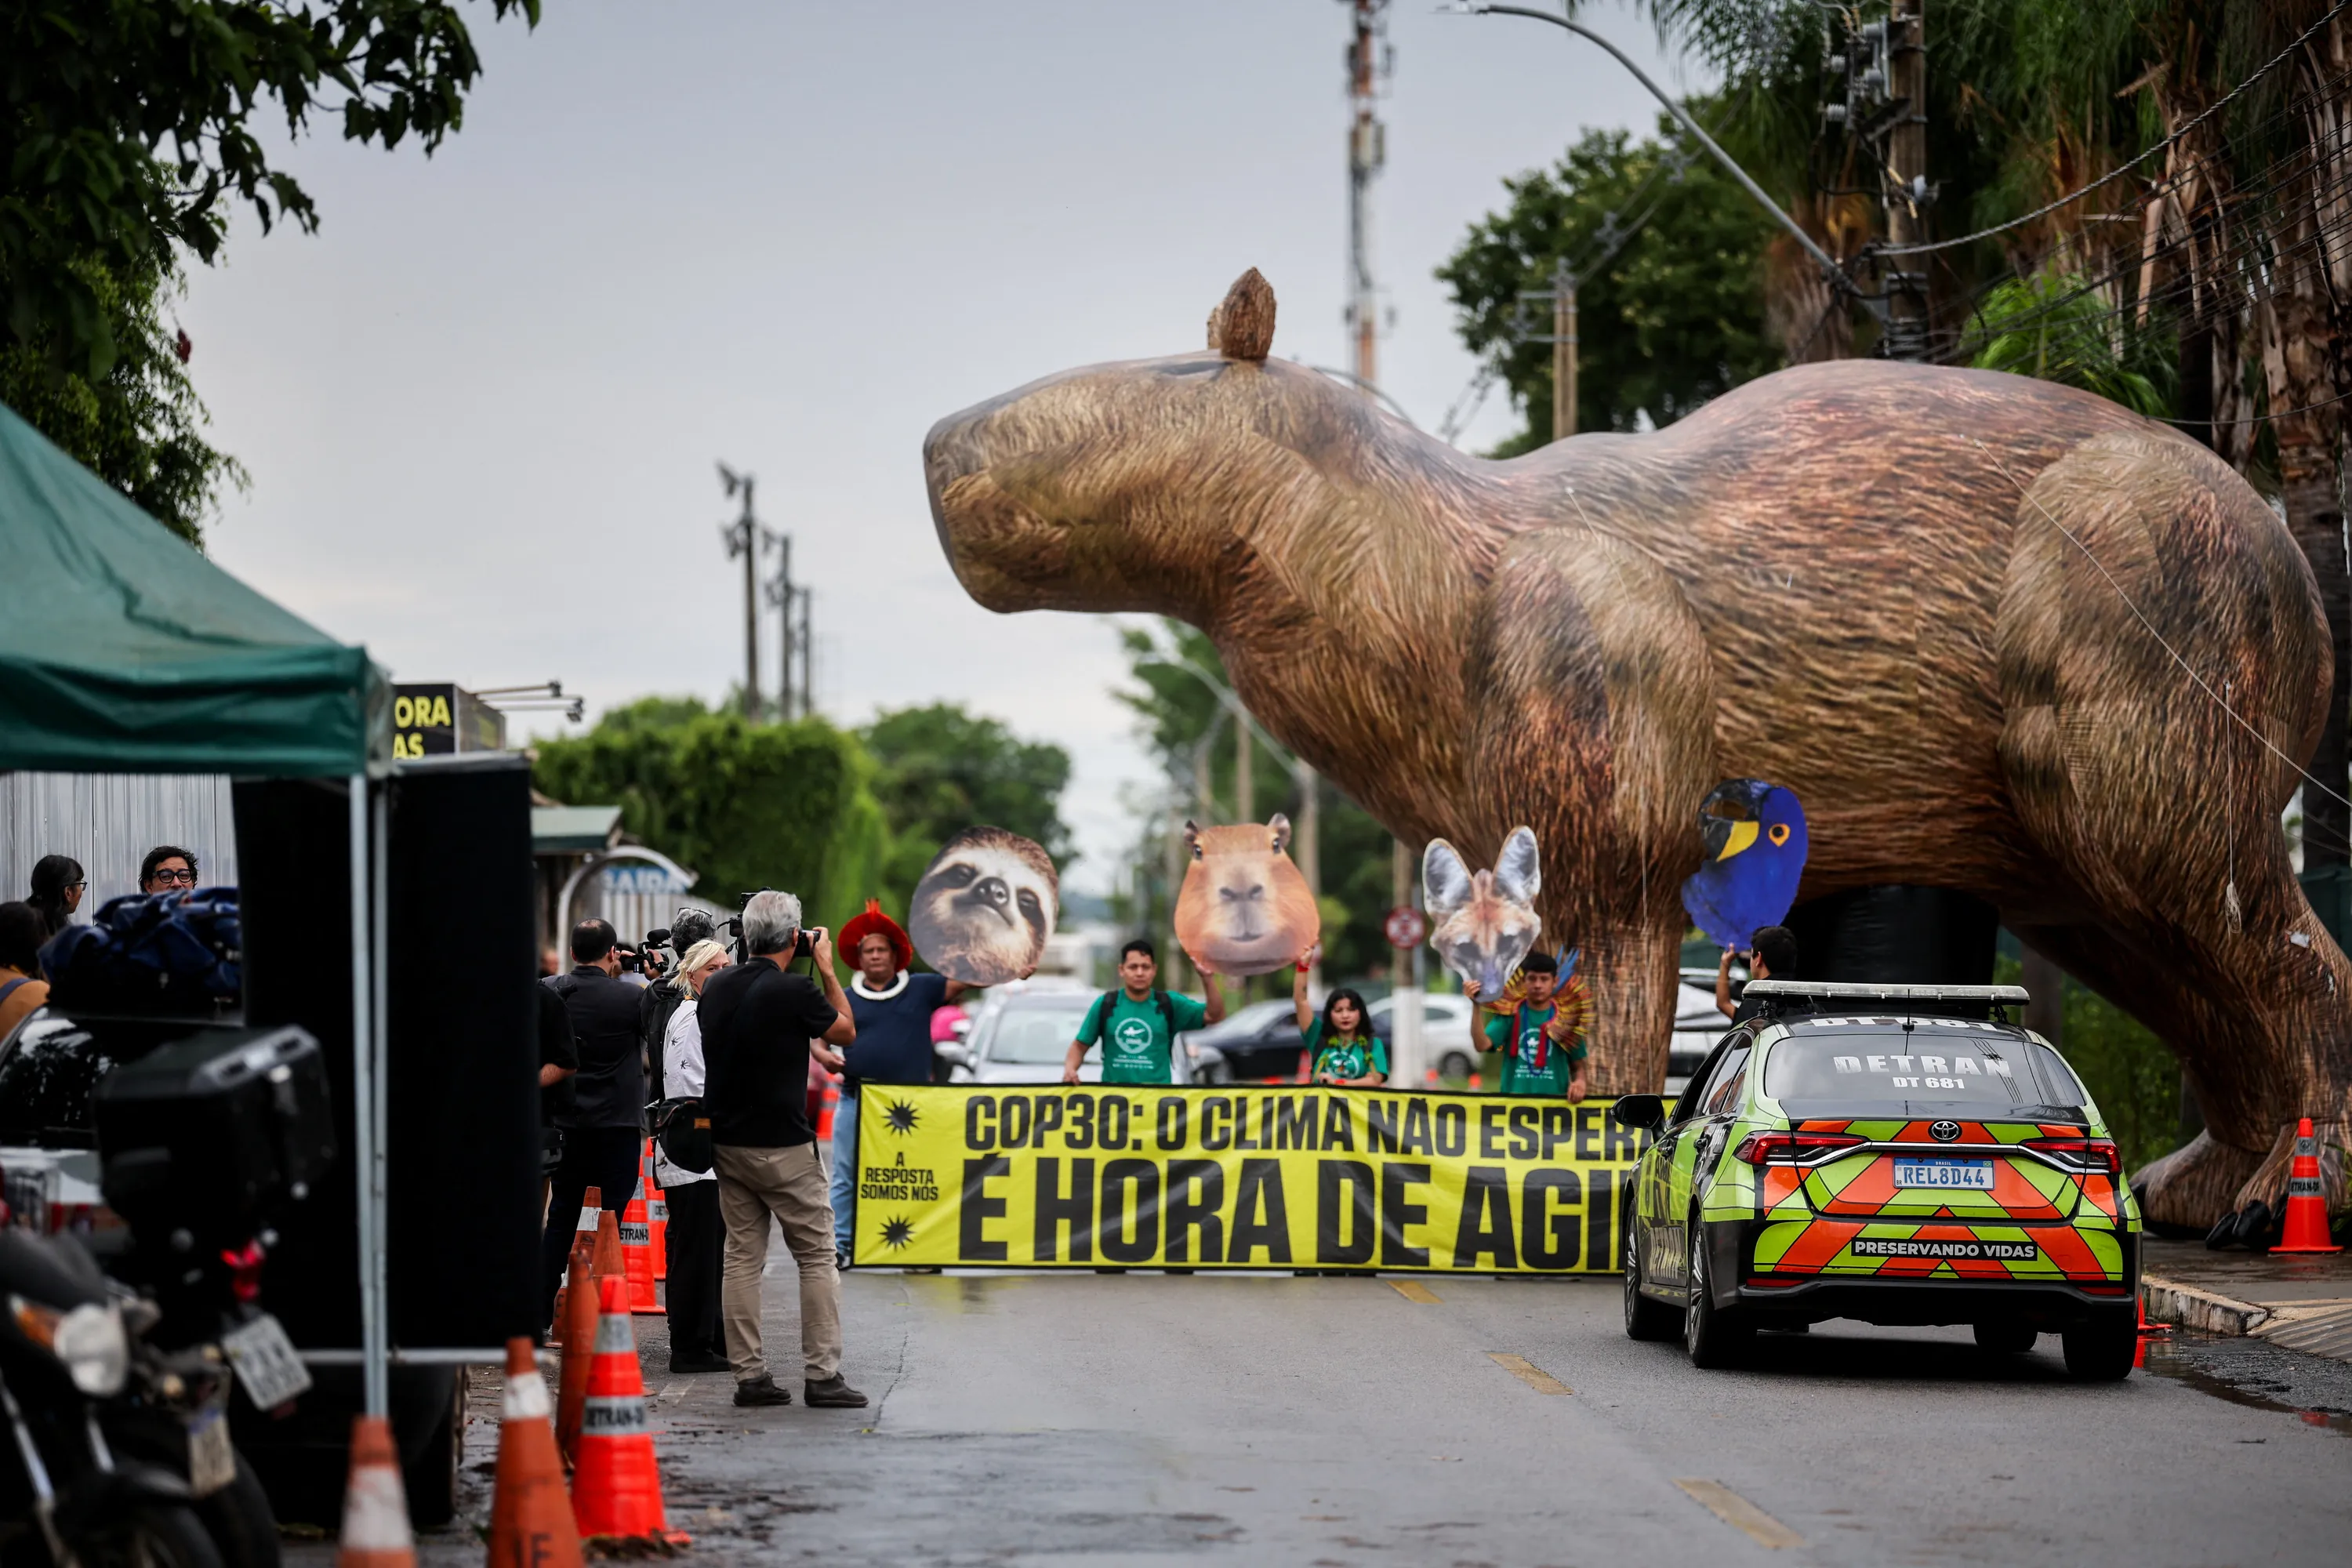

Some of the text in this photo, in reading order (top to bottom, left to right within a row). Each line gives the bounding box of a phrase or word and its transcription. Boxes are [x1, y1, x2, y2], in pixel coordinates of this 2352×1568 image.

[1833, 1055, 2012, 1077] DETRAN
[1893, 1077, 1965, 1089] DT 681
[965, 1094, 1142, 1150] COP30:
[1156, 1097, 1187, 1150] O
[1201, 1095, 1354, 1151] CLIMA
[1367, 1098, 1467, 1157] NÃO
[895, 1151, 904, 1167] A
[866, 1167, 934, 1185] RESPOSTA
[1904, 1167, 1984, 1185] REL8D44
[861, 1184, 908, 1200] SOMOS
[959, 1152, 1010, 1261] É
[1034, 1157, 1292, 1263] HORA
[1317, 1160, 1430, 1267] DE
[1855, 1241, 2035, 1258] PRESERVANDO VIDAS
